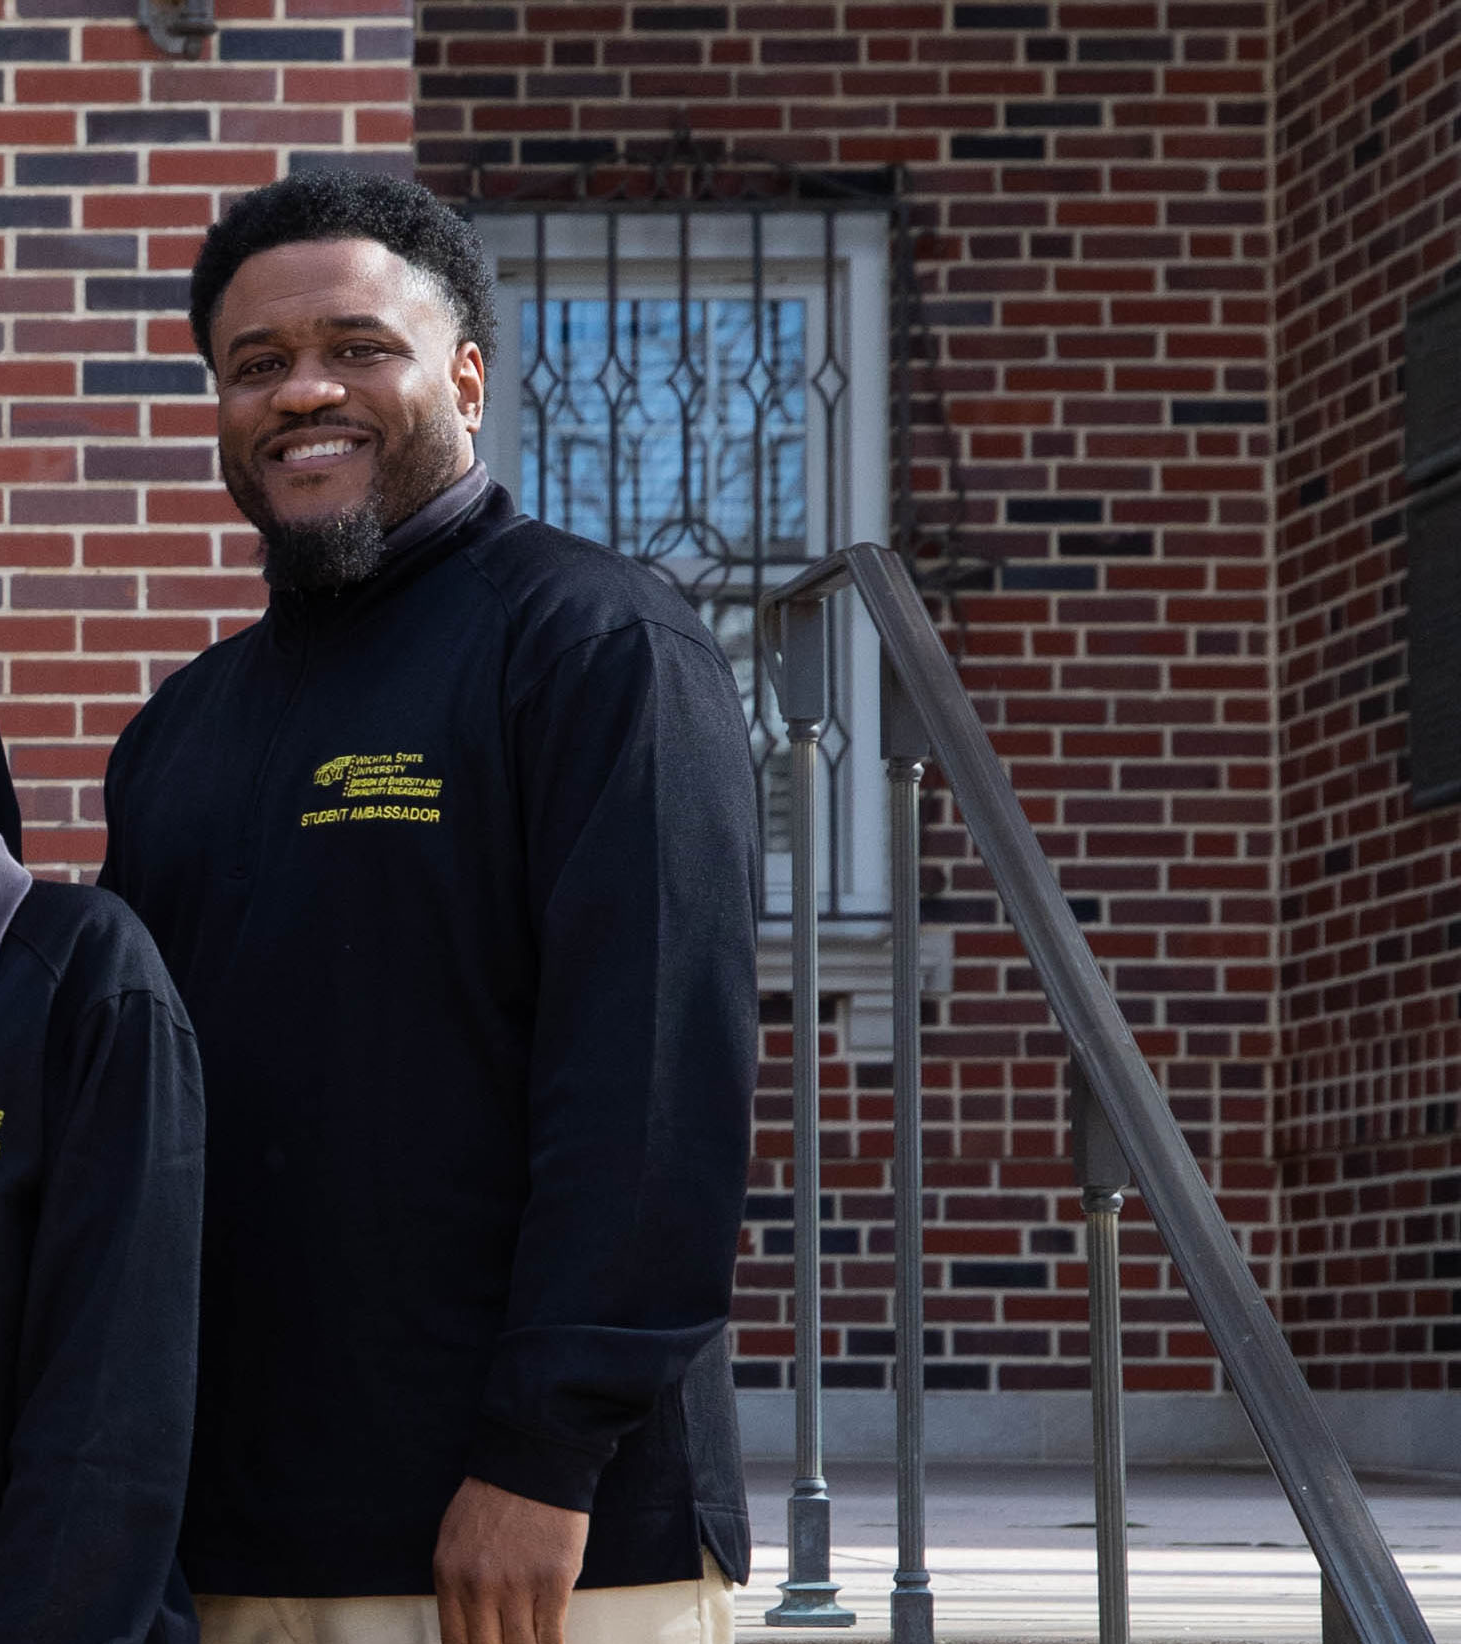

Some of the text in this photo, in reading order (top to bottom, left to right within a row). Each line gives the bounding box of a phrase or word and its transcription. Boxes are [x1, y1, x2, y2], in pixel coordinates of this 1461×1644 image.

[356, 752, 424, 764] WICHITA STATE
[353, 765, 406, 775] UNIVERSITY
[302, 805, 441, 826] STUDENT AMBASSADOR
